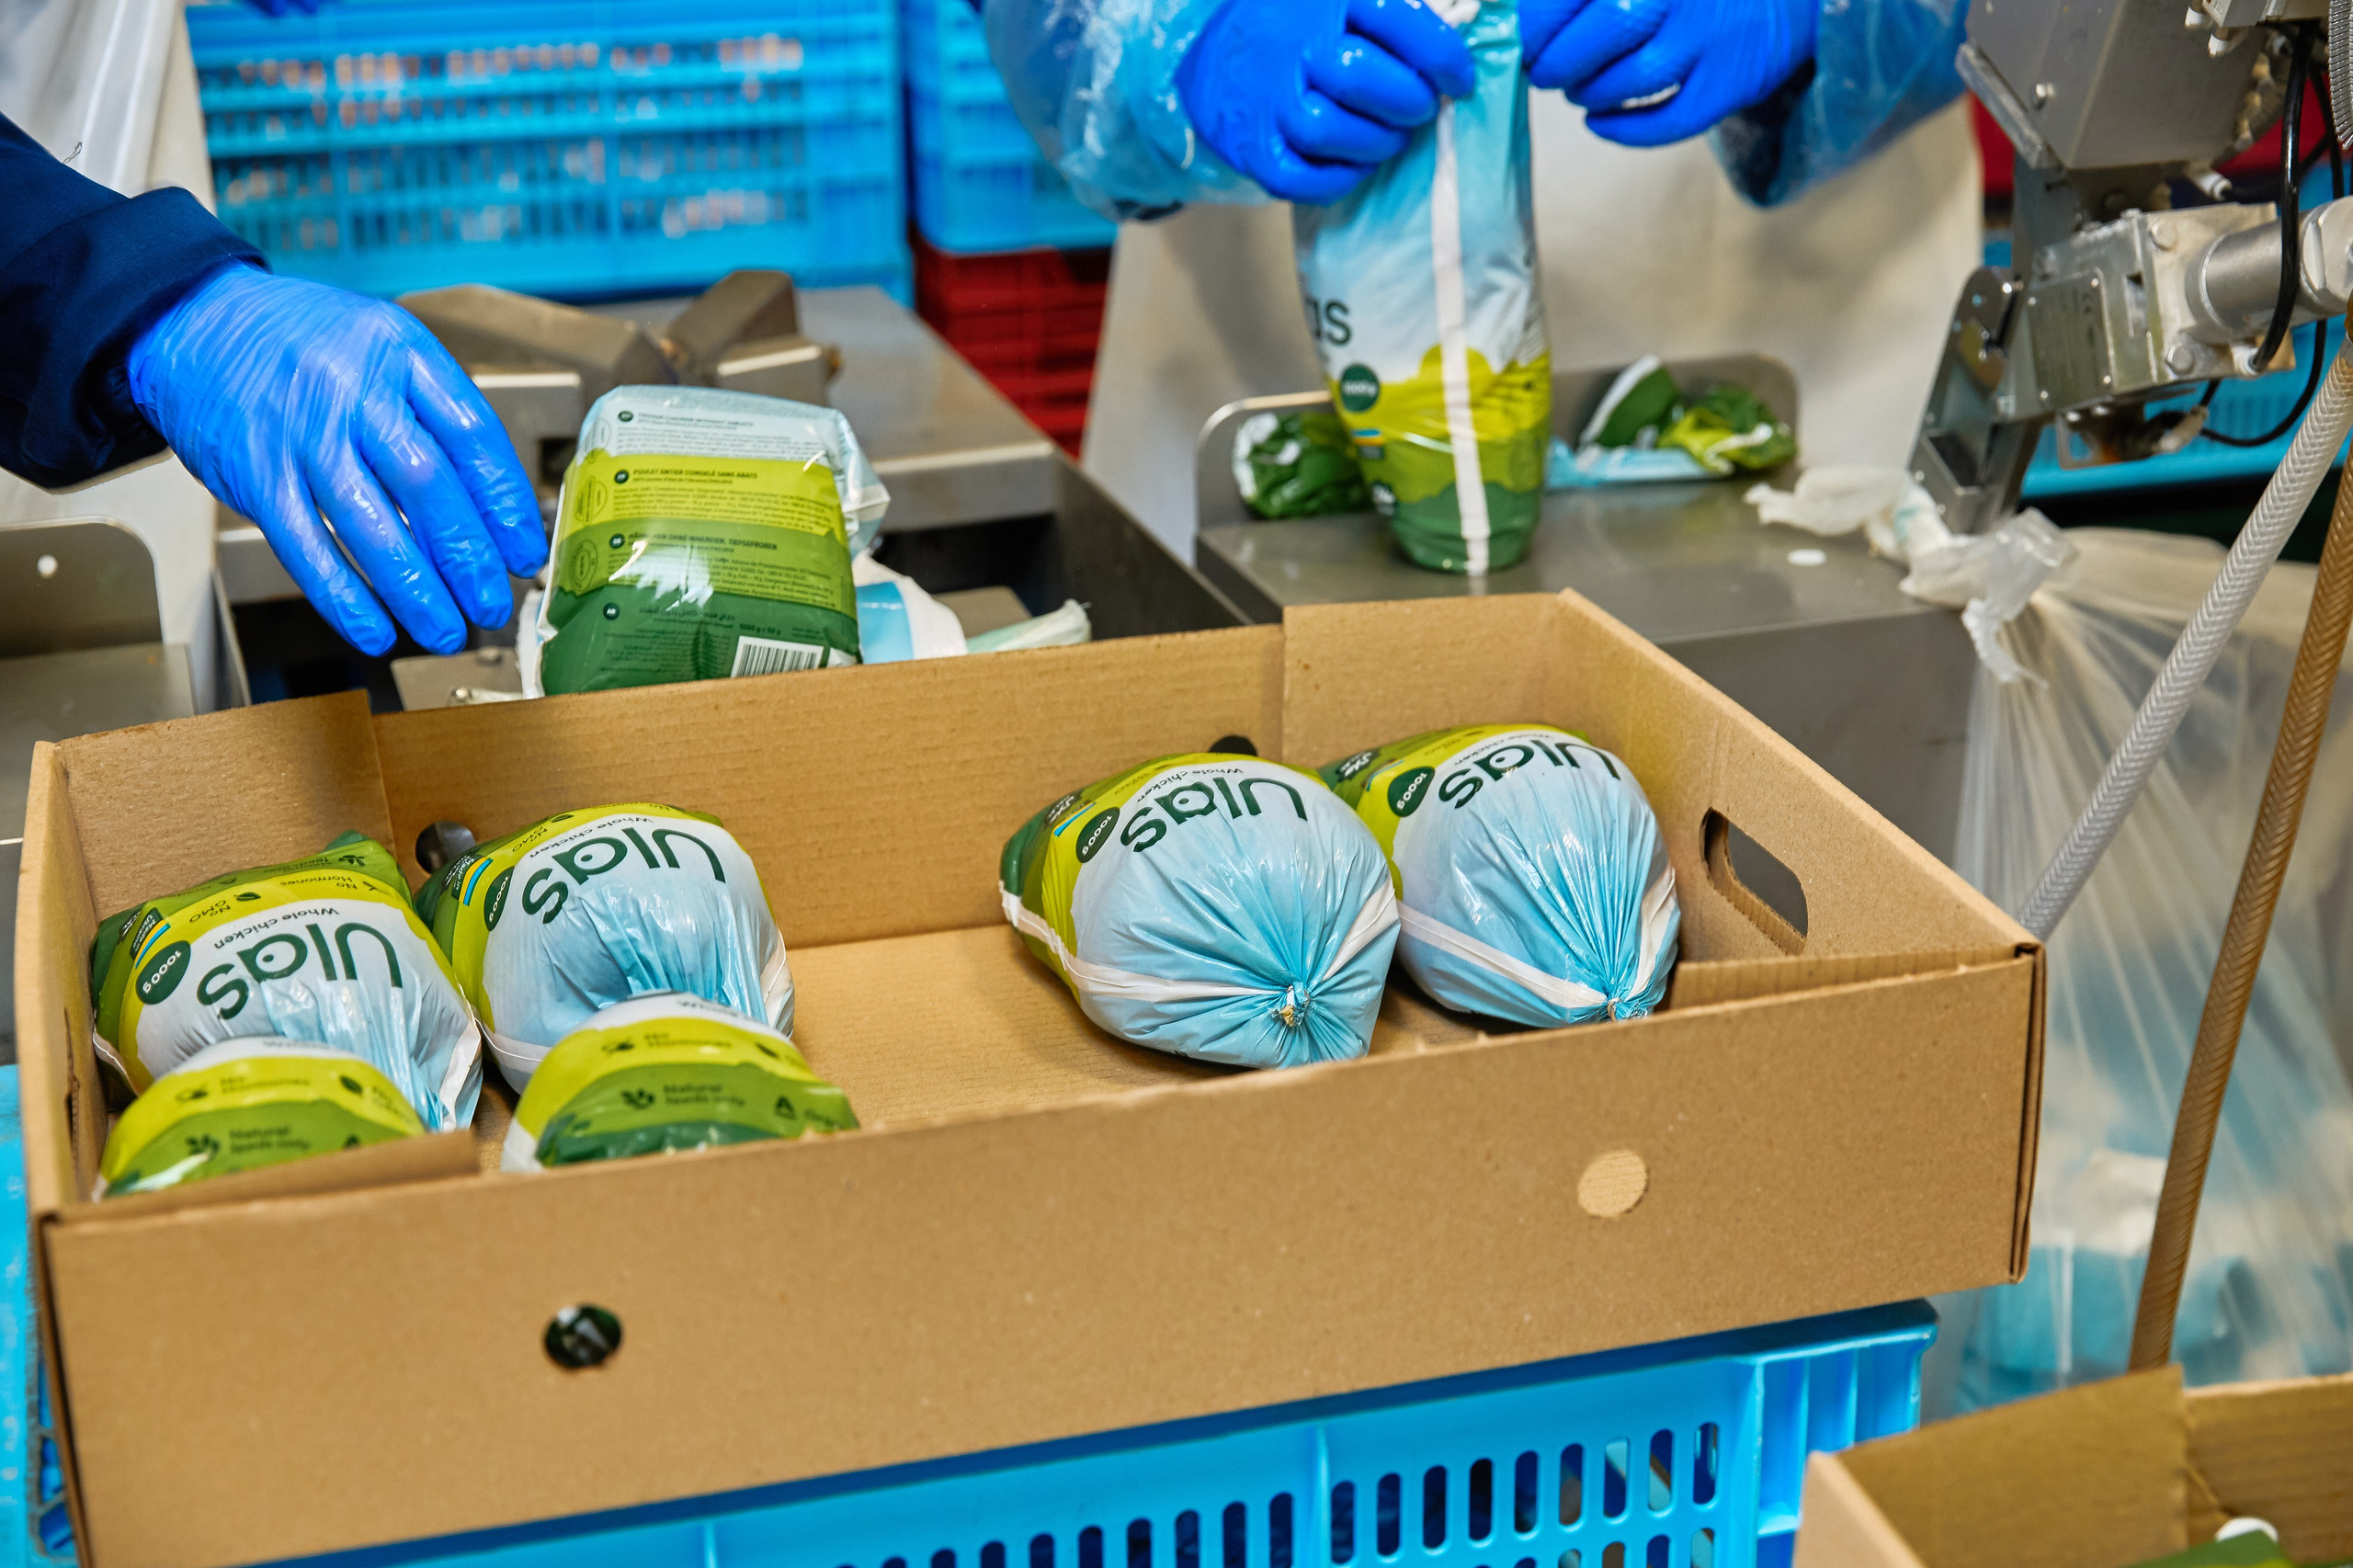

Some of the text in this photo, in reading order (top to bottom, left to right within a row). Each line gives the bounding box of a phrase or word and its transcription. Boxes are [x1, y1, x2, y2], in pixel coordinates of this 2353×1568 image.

[1137, 770, 1188, 802] chicken
[1438, 738, 1621, 810] Ulas
[1082, 813, 1113, 855] 1000g
[1120, 777, 1309, 853] Ulas
[529, 828, 594, 858] chicken
[279, 874, 353, 887] Hormones
[335, 881, 358, 891] No
[522, 827, 727, 925] Ulas
[189, 899, 227, 924] GMO
[210, 904, 232, 917] No
[213, 906, 340, 950] Whole chicken
[142, 949, 183, 994] 1000g
[197, 922, 403, 1020] Ulas
